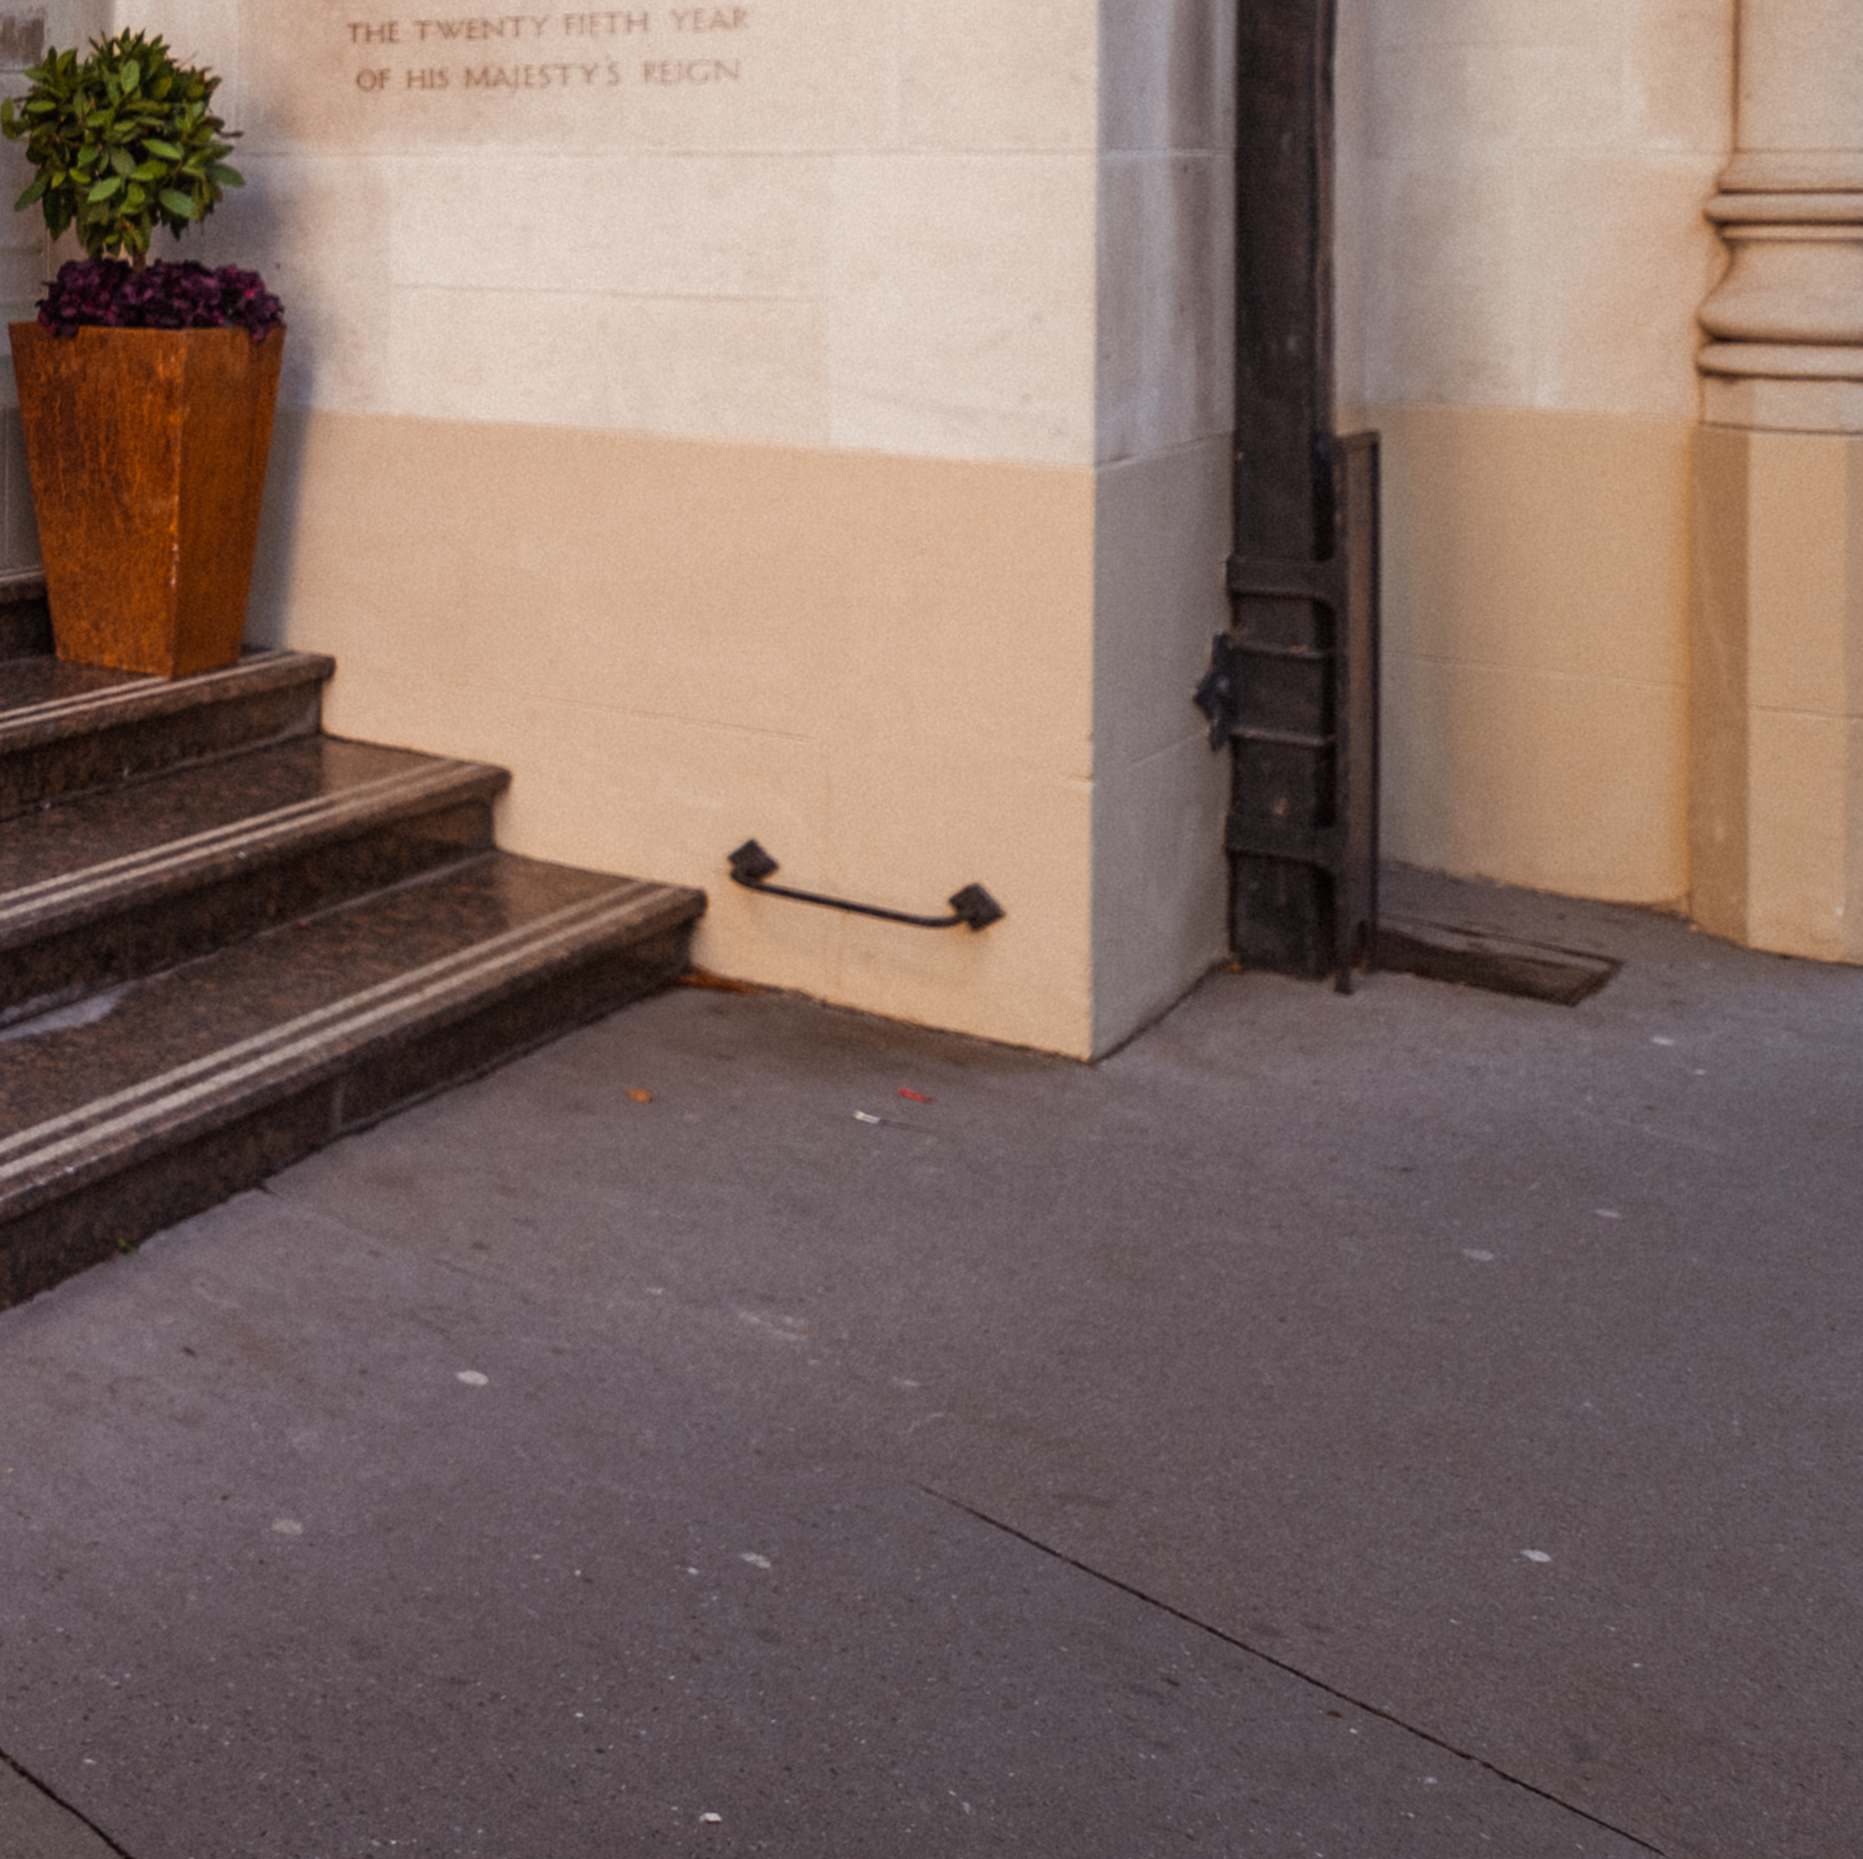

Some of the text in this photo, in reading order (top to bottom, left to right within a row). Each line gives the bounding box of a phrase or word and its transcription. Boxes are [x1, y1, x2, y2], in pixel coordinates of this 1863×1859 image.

[347, 7, 747, 43] THE TWENTY FIFTH YEAR
[356, 70, 389, 91] OF
[407, 69, 447, 88] HIS
[643, 59, 740, 85] REIGN
